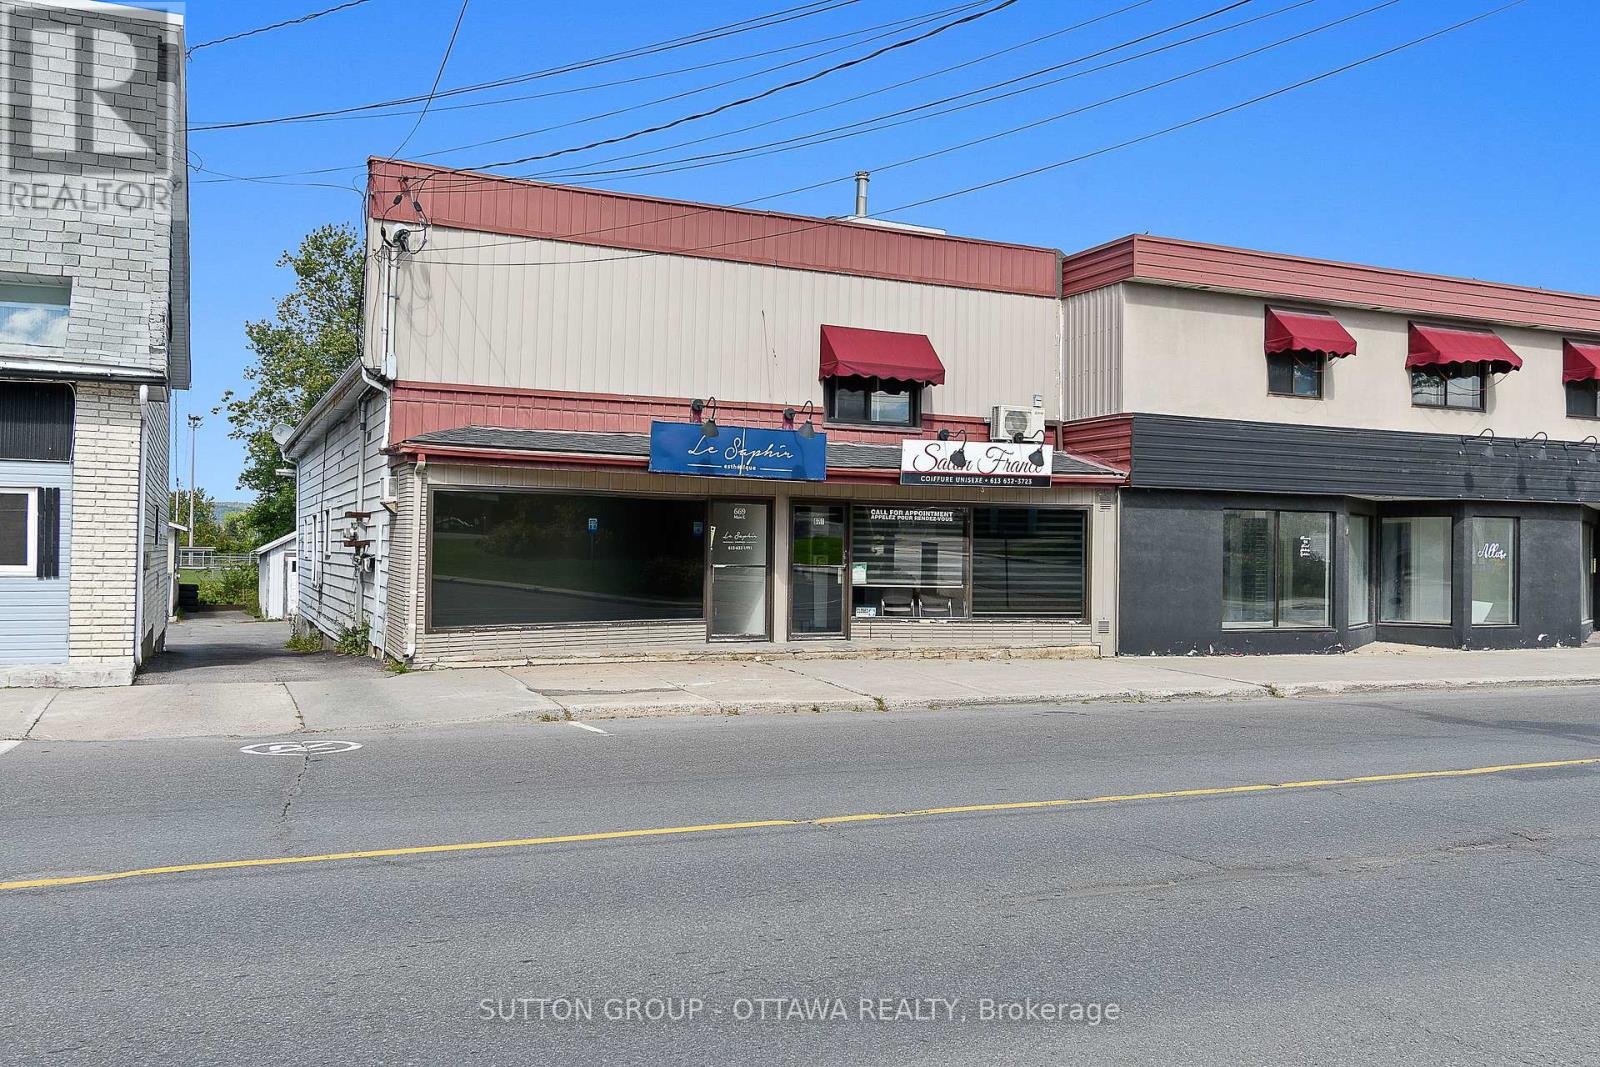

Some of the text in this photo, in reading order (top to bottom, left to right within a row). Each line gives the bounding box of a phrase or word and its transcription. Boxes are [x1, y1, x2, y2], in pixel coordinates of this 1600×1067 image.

[688, 434, 718, 455] Le
[912, 442, 973, 473] San
[920, 475, 954, 483] COIFFURE
[955, 476, 983, 484] UNISEXE
[989, 477, 1001, 485] 613
[733, 507, 746, 515] 669
